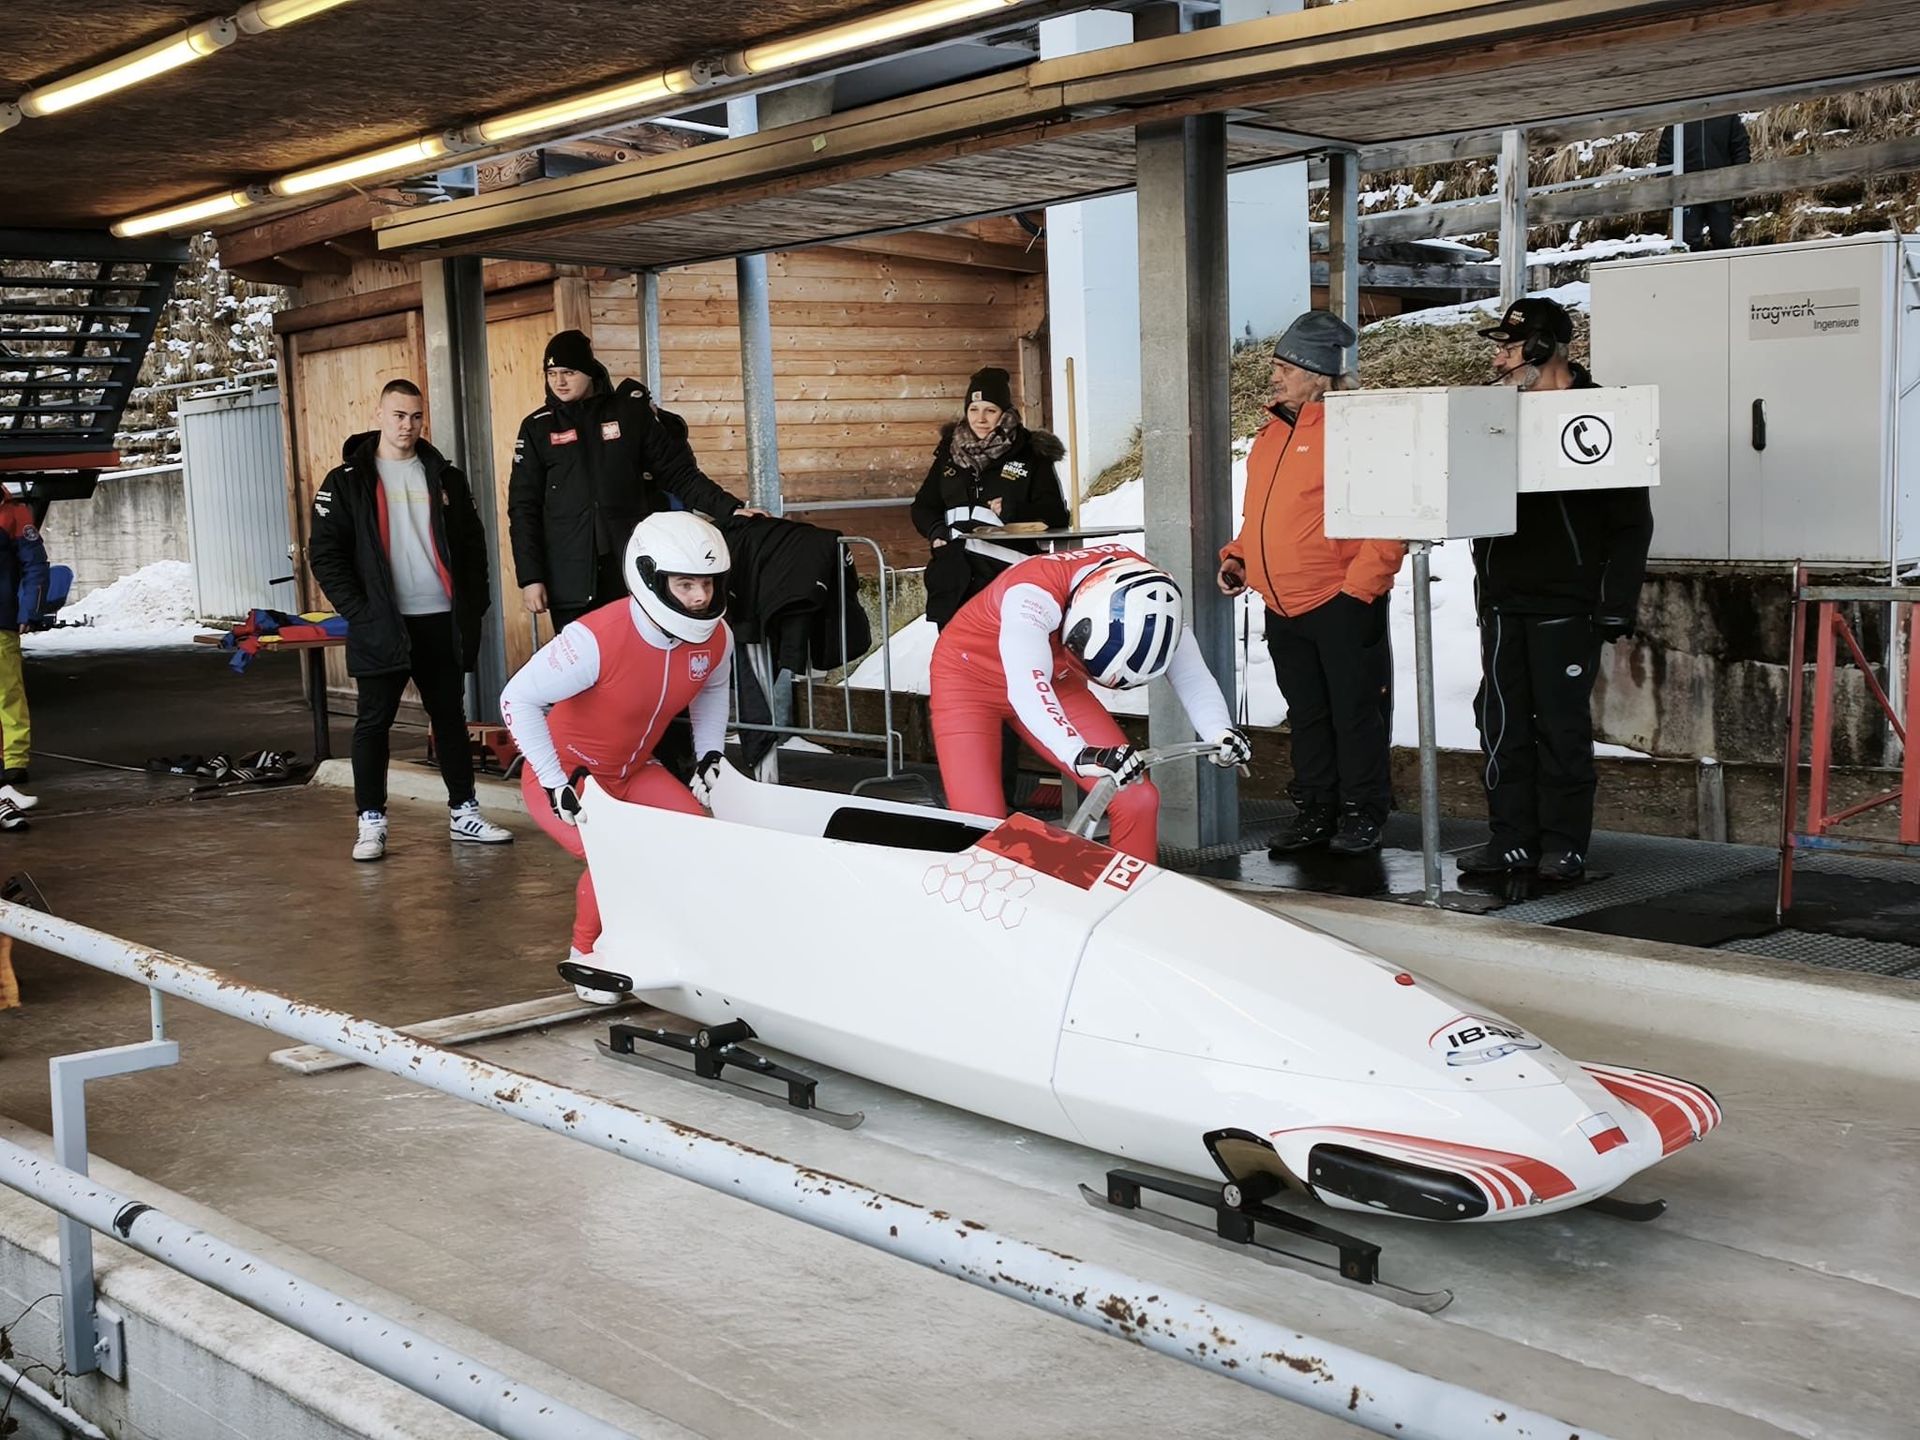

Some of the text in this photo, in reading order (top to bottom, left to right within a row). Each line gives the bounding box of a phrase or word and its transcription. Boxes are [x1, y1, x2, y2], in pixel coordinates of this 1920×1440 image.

[1751, 298, 1815, 324] tragwerk
[1813, 319, 1860, 331] Ingenieure
[1032, 669, 1078, 738] POLSKA
